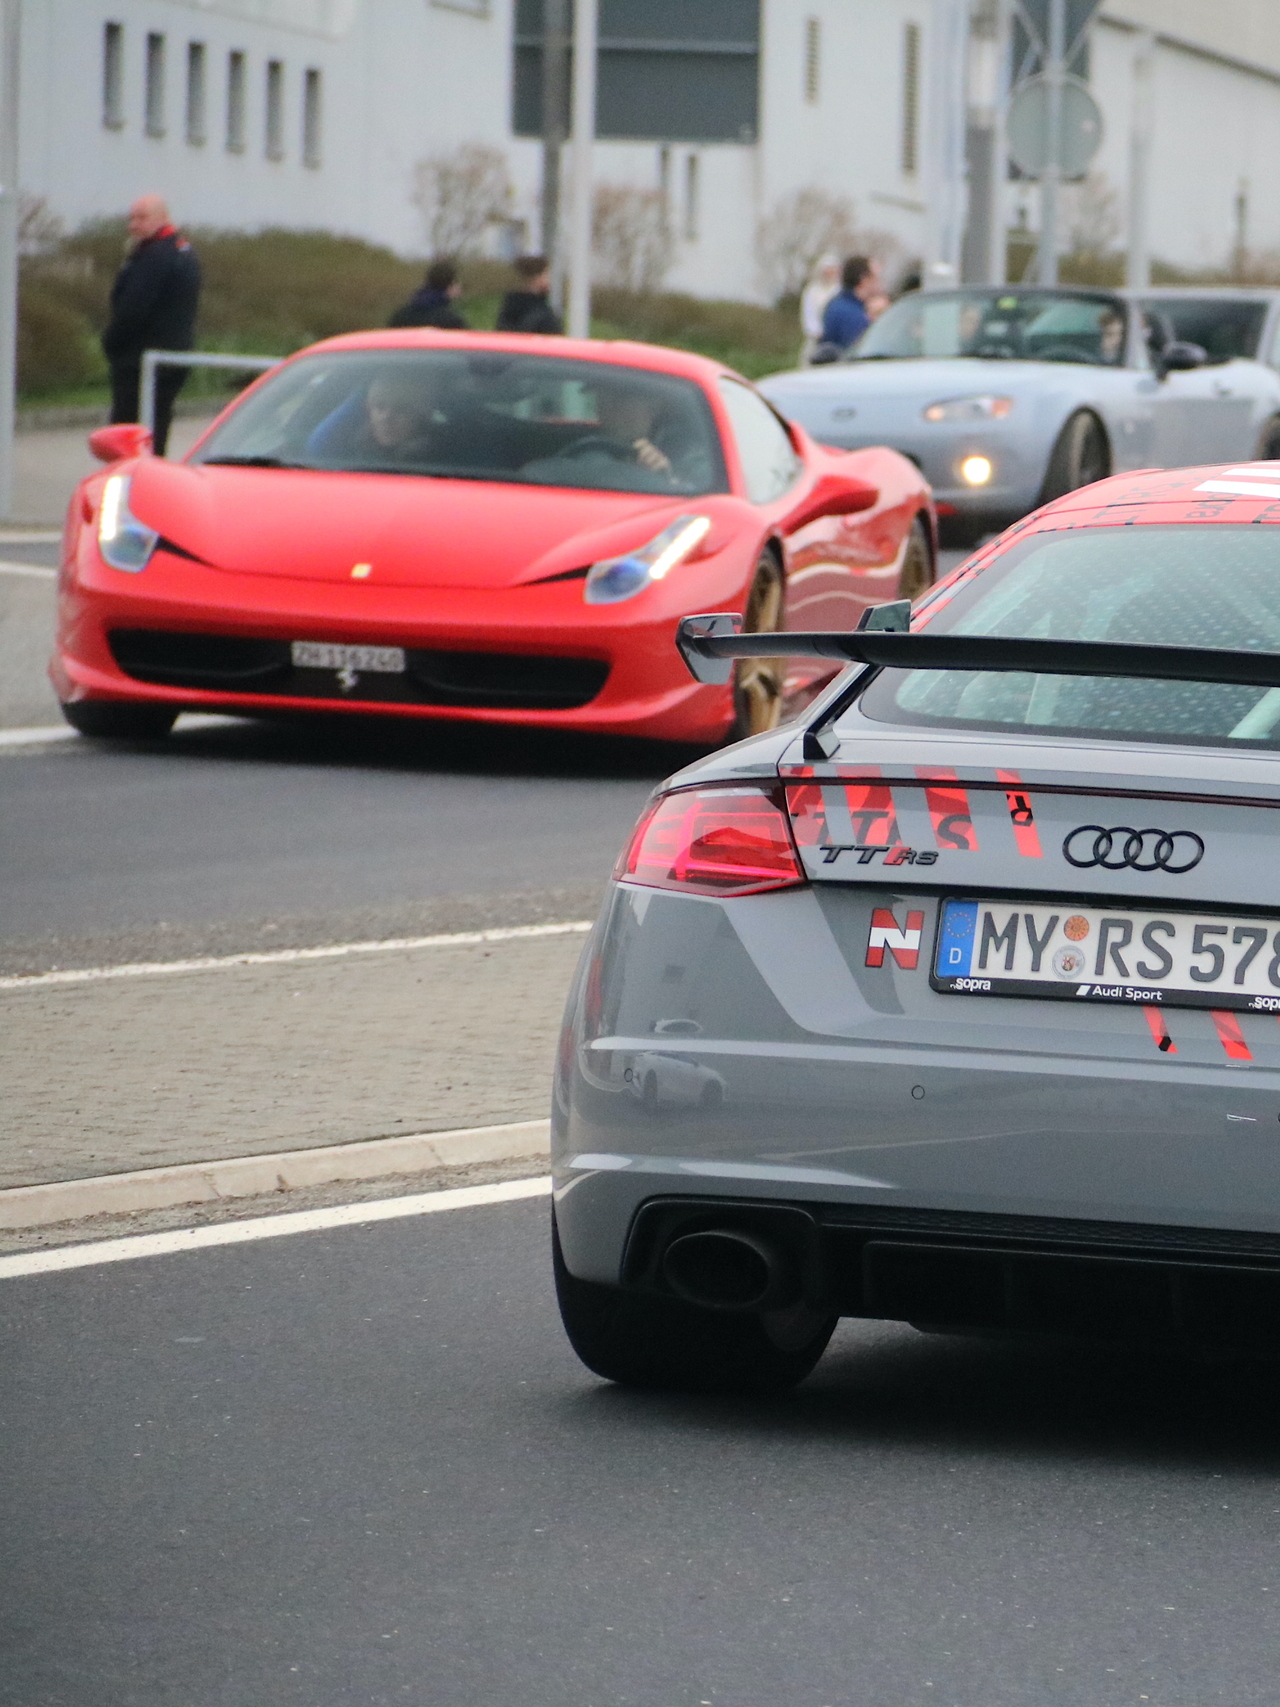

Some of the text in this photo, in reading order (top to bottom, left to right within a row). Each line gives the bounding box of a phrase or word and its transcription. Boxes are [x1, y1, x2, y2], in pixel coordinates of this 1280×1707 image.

[865, 908, 924, 970] N
[977, 911, 1059, 972] MY
[1094, 918, 1176, 980] RS
[949, 947, 962, 965] D
[955, 977, 991, 991] sopra
[1092, 985, 1163, 1002] Audi Sport
